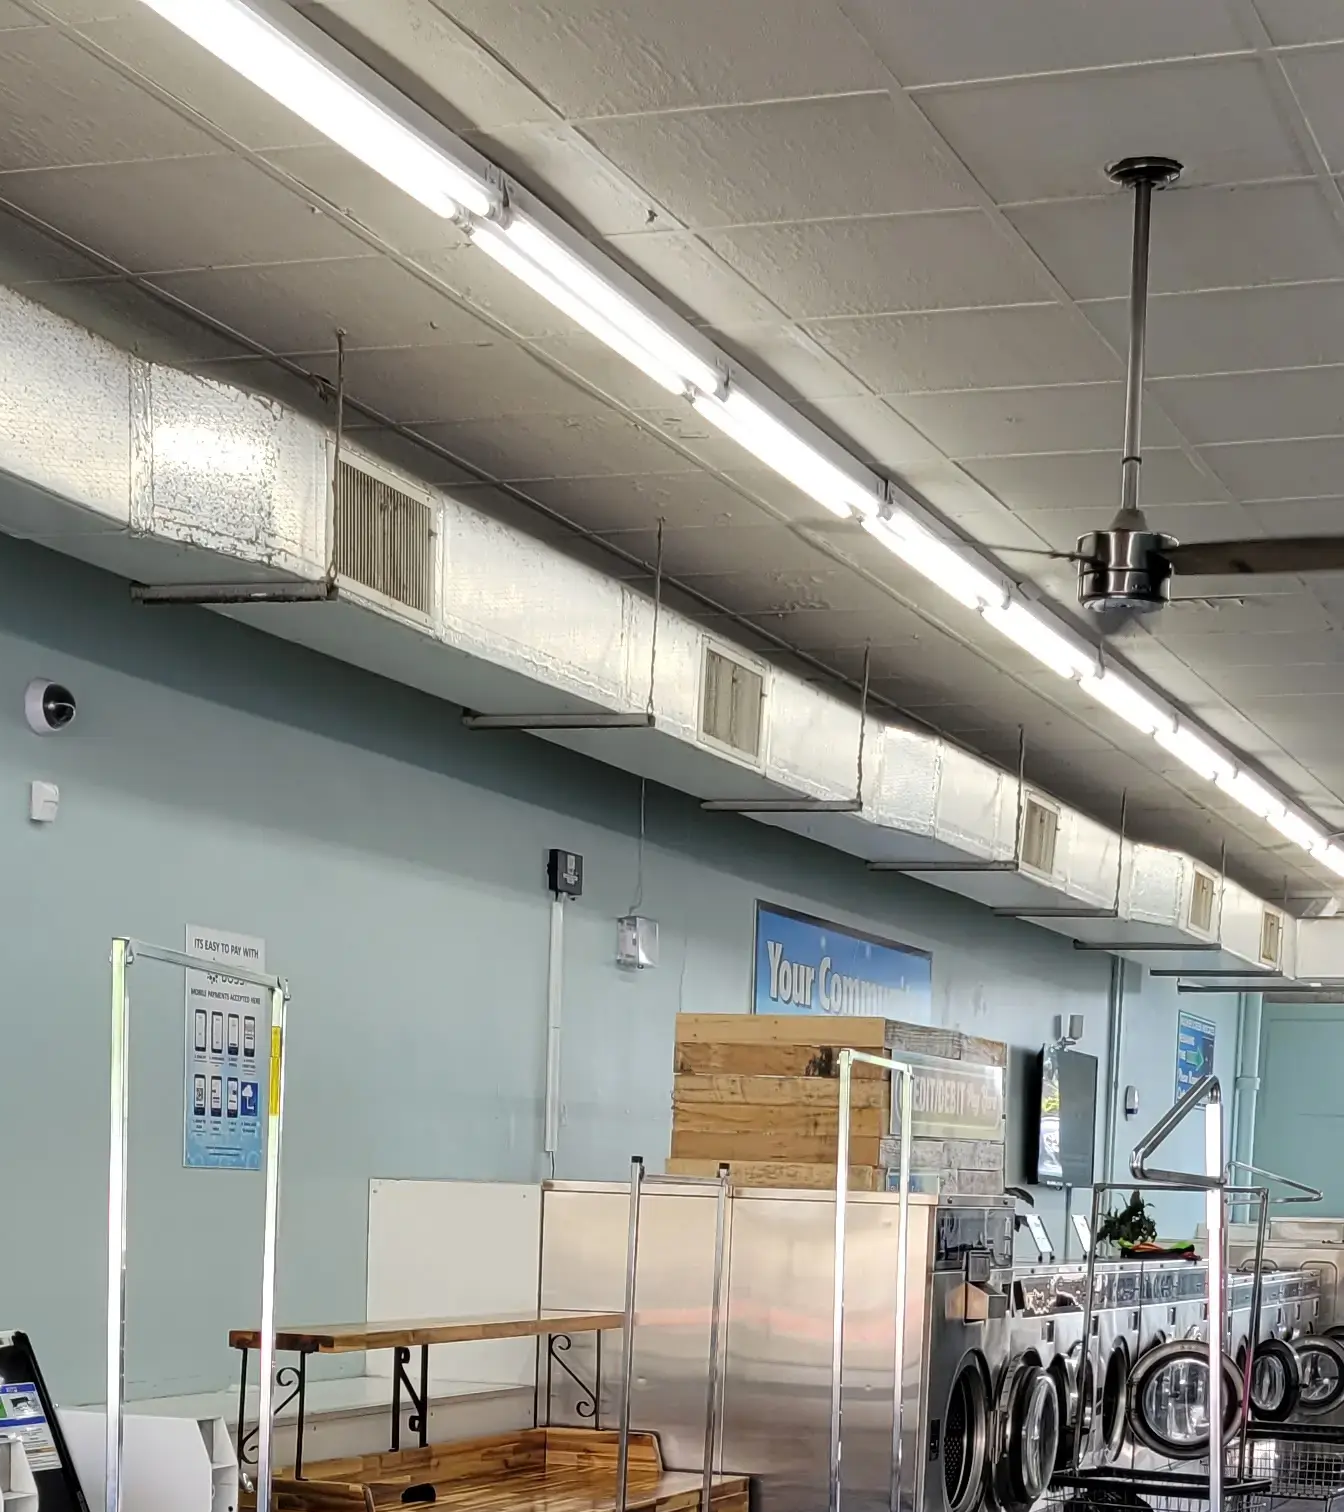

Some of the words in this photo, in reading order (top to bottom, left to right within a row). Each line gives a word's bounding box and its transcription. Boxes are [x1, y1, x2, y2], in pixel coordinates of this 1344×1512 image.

[194, 938, 204, 949] ITS
[205, 940, 220, 953] EASY
[221, 943, 230, 954] TO
[231, 945, 242, 956] PAY
[243, 947, 259, 959] WITH
[766, 939, 816, 1009] Your
